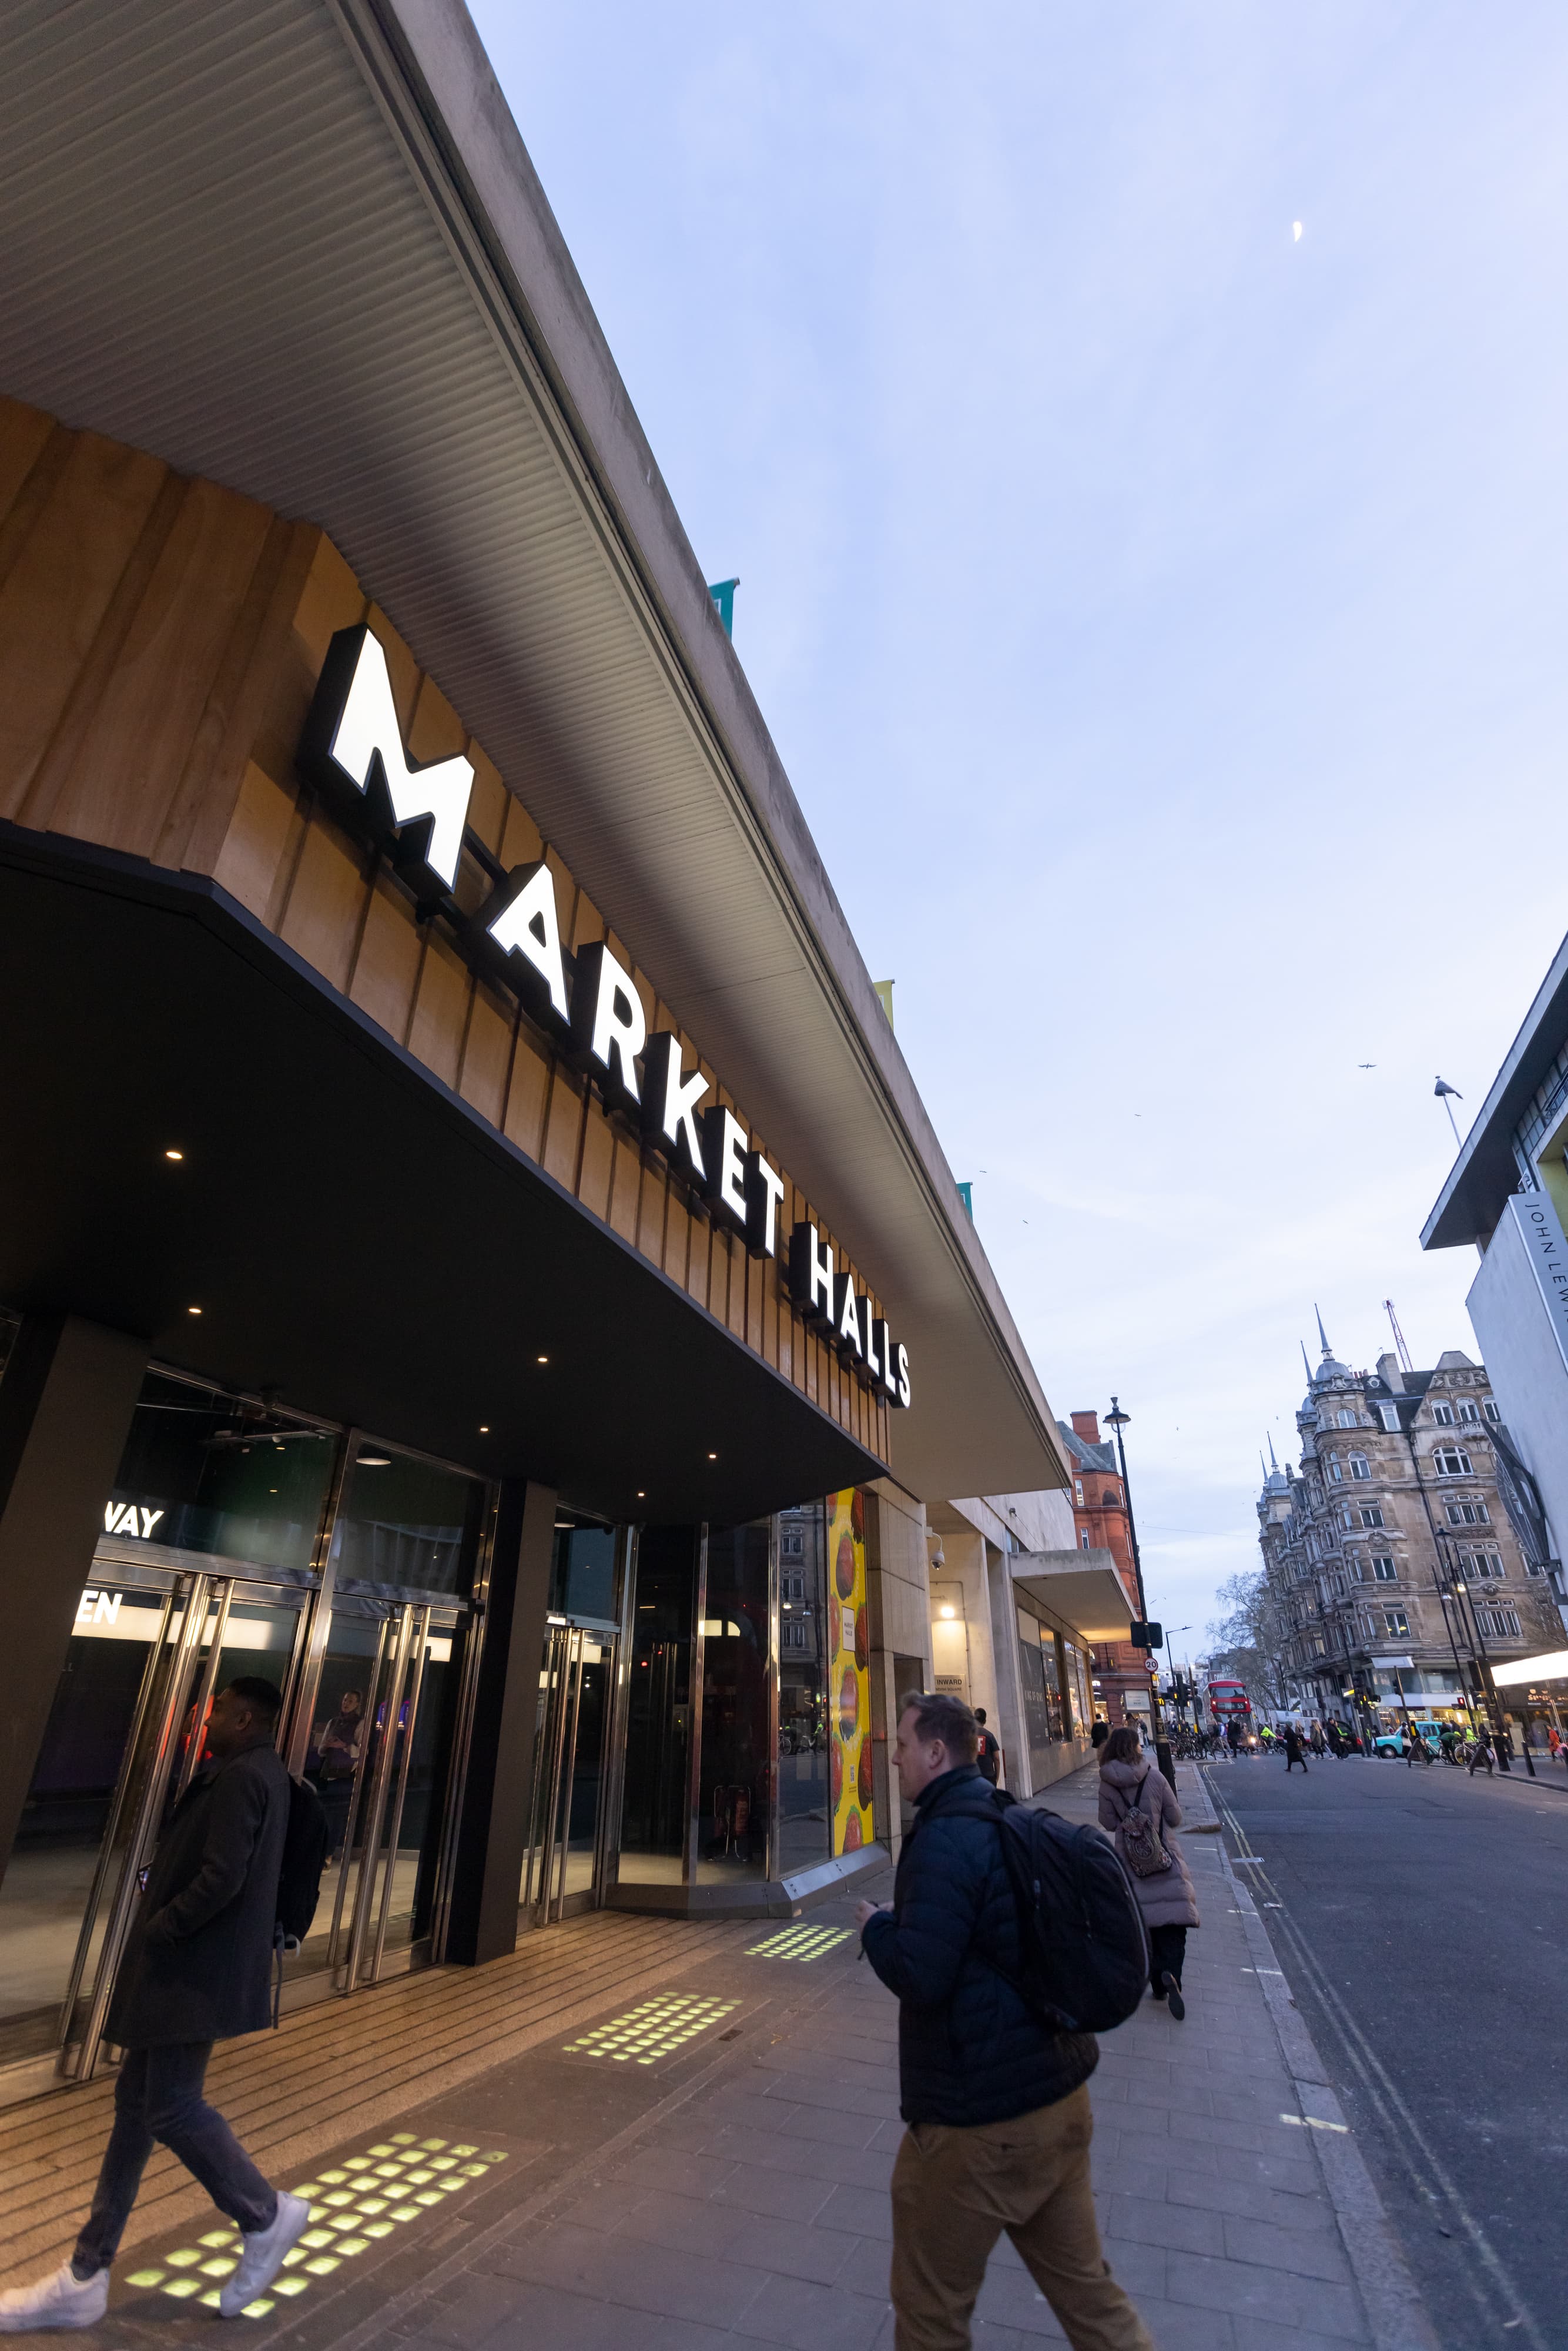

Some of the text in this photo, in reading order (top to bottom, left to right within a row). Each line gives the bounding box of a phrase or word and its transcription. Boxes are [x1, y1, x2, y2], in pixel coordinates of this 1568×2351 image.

[328, 628, 911, 1409] MARKET HALLS
[1525, 1204, 1568, 1322] JOHN LEW
